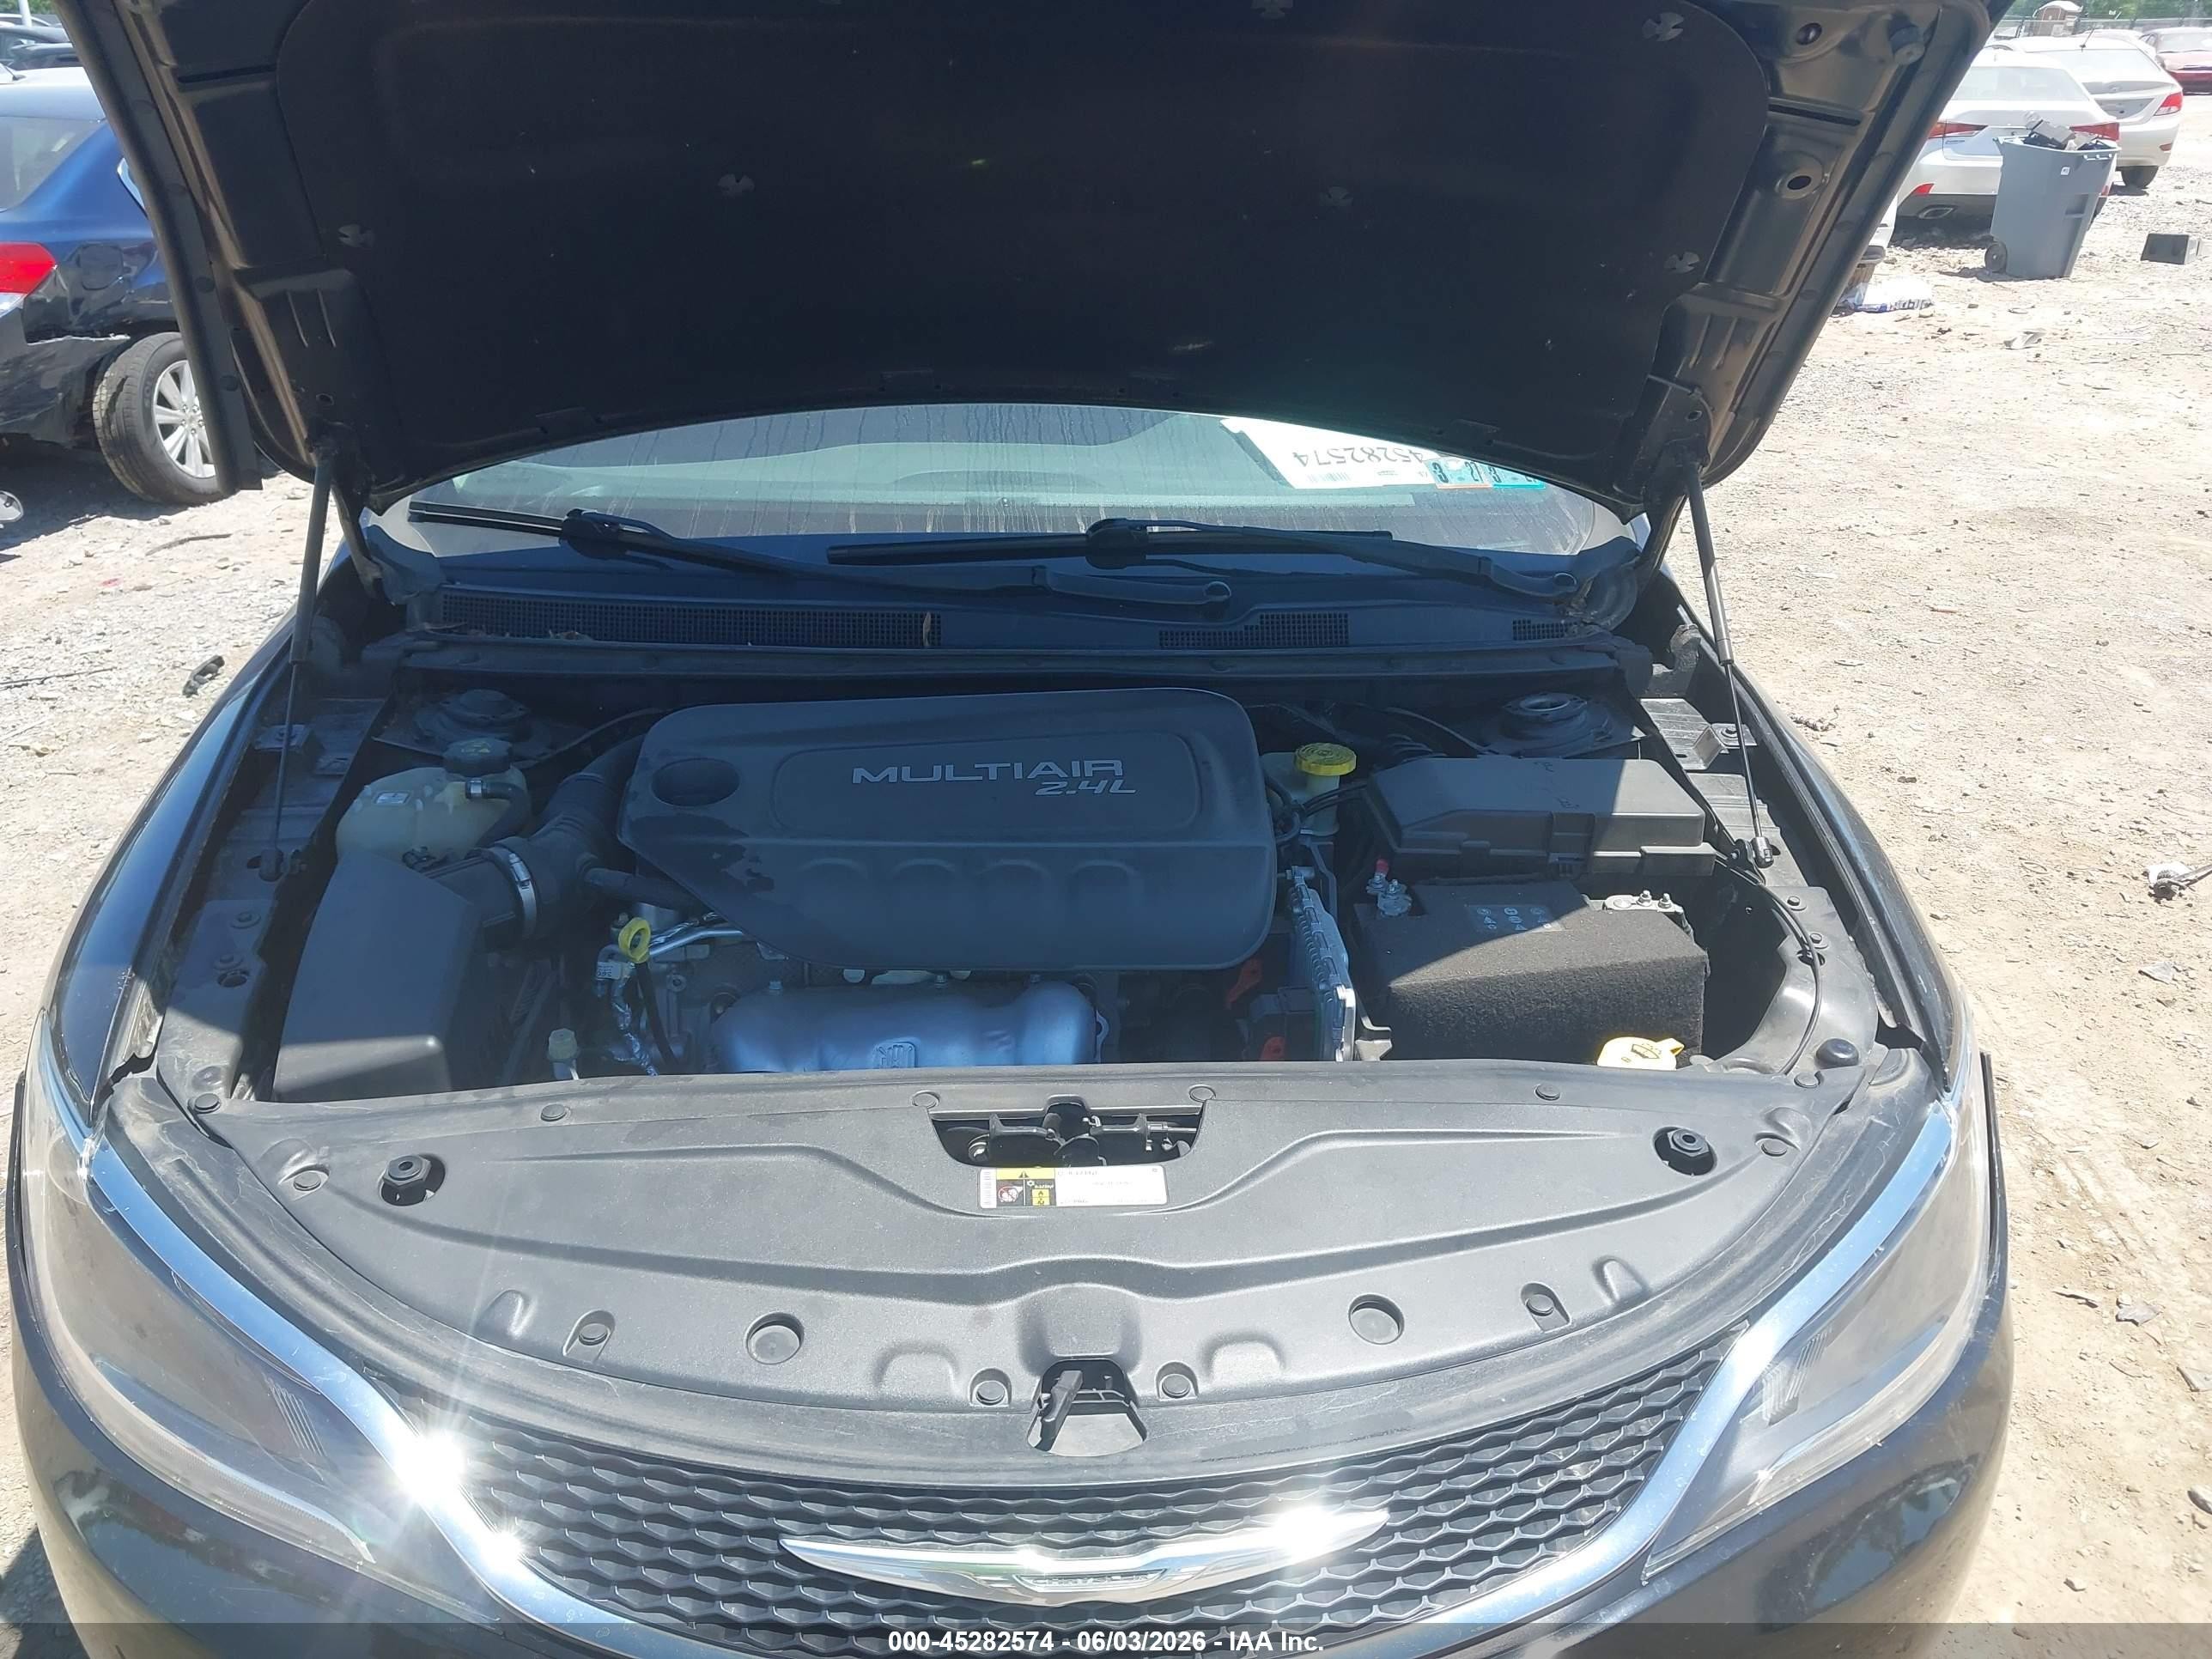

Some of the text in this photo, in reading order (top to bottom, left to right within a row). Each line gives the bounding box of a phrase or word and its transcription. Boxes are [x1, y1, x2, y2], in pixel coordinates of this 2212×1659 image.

[1292, 447, 1423, 466] 45282574
[853, 760, 1123, 784] MULTIAIR
[1036, 780, 1136, 795] 2.4L
